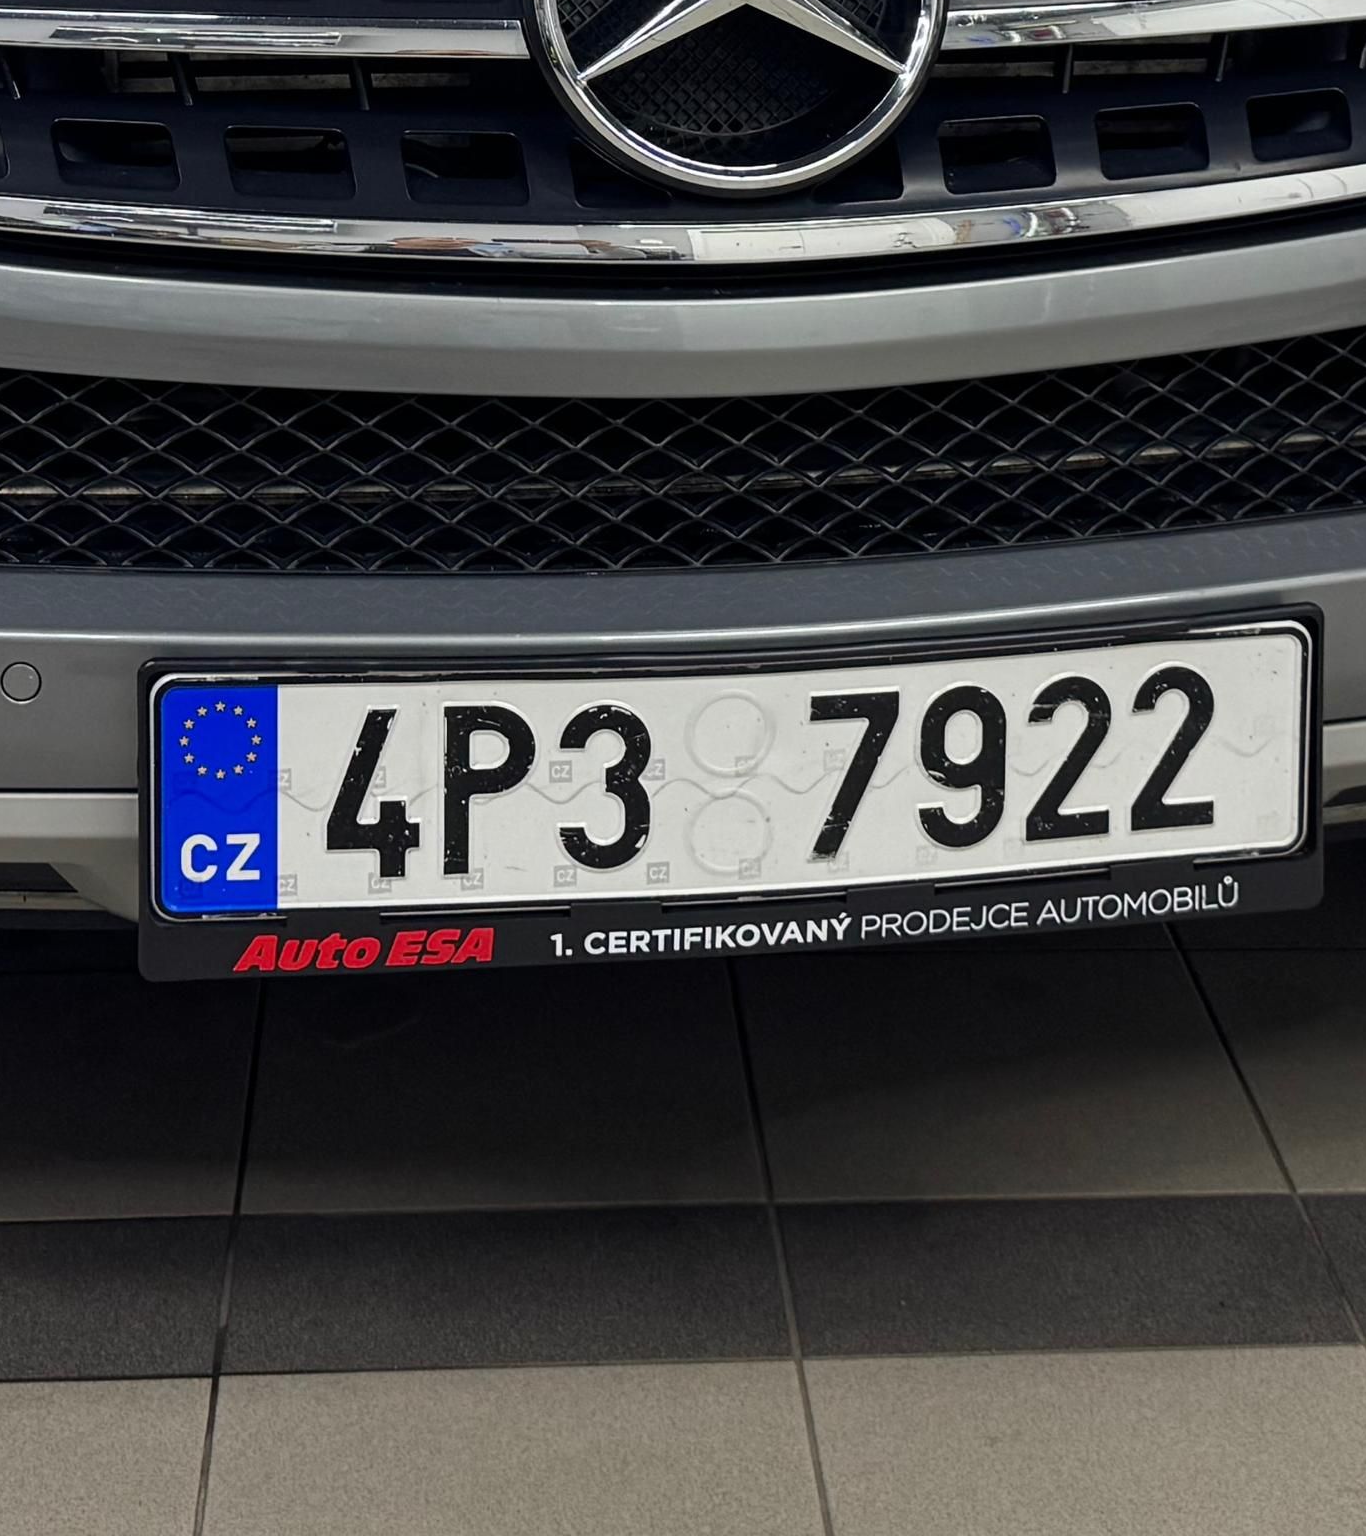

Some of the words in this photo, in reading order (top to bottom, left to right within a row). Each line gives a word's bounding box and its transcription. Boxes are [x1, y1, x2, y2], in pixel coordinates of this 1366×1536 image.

[326, 703, 652, 879] 4P3
[808, 664, 1216, 862] 7922
[180, 832, 261, 882] CZ
[233, 932, 381, 971] Auto
[385, 927, 494, 966] ESA
[550, 933, 573, 957] 1.
[584, 912, 853, 955] CERTIFIKOVANÝ
[860, 902, 1030, 940] PRODEJCE
[1036, 875, 1240, 926] AUTOMOBILŮ
